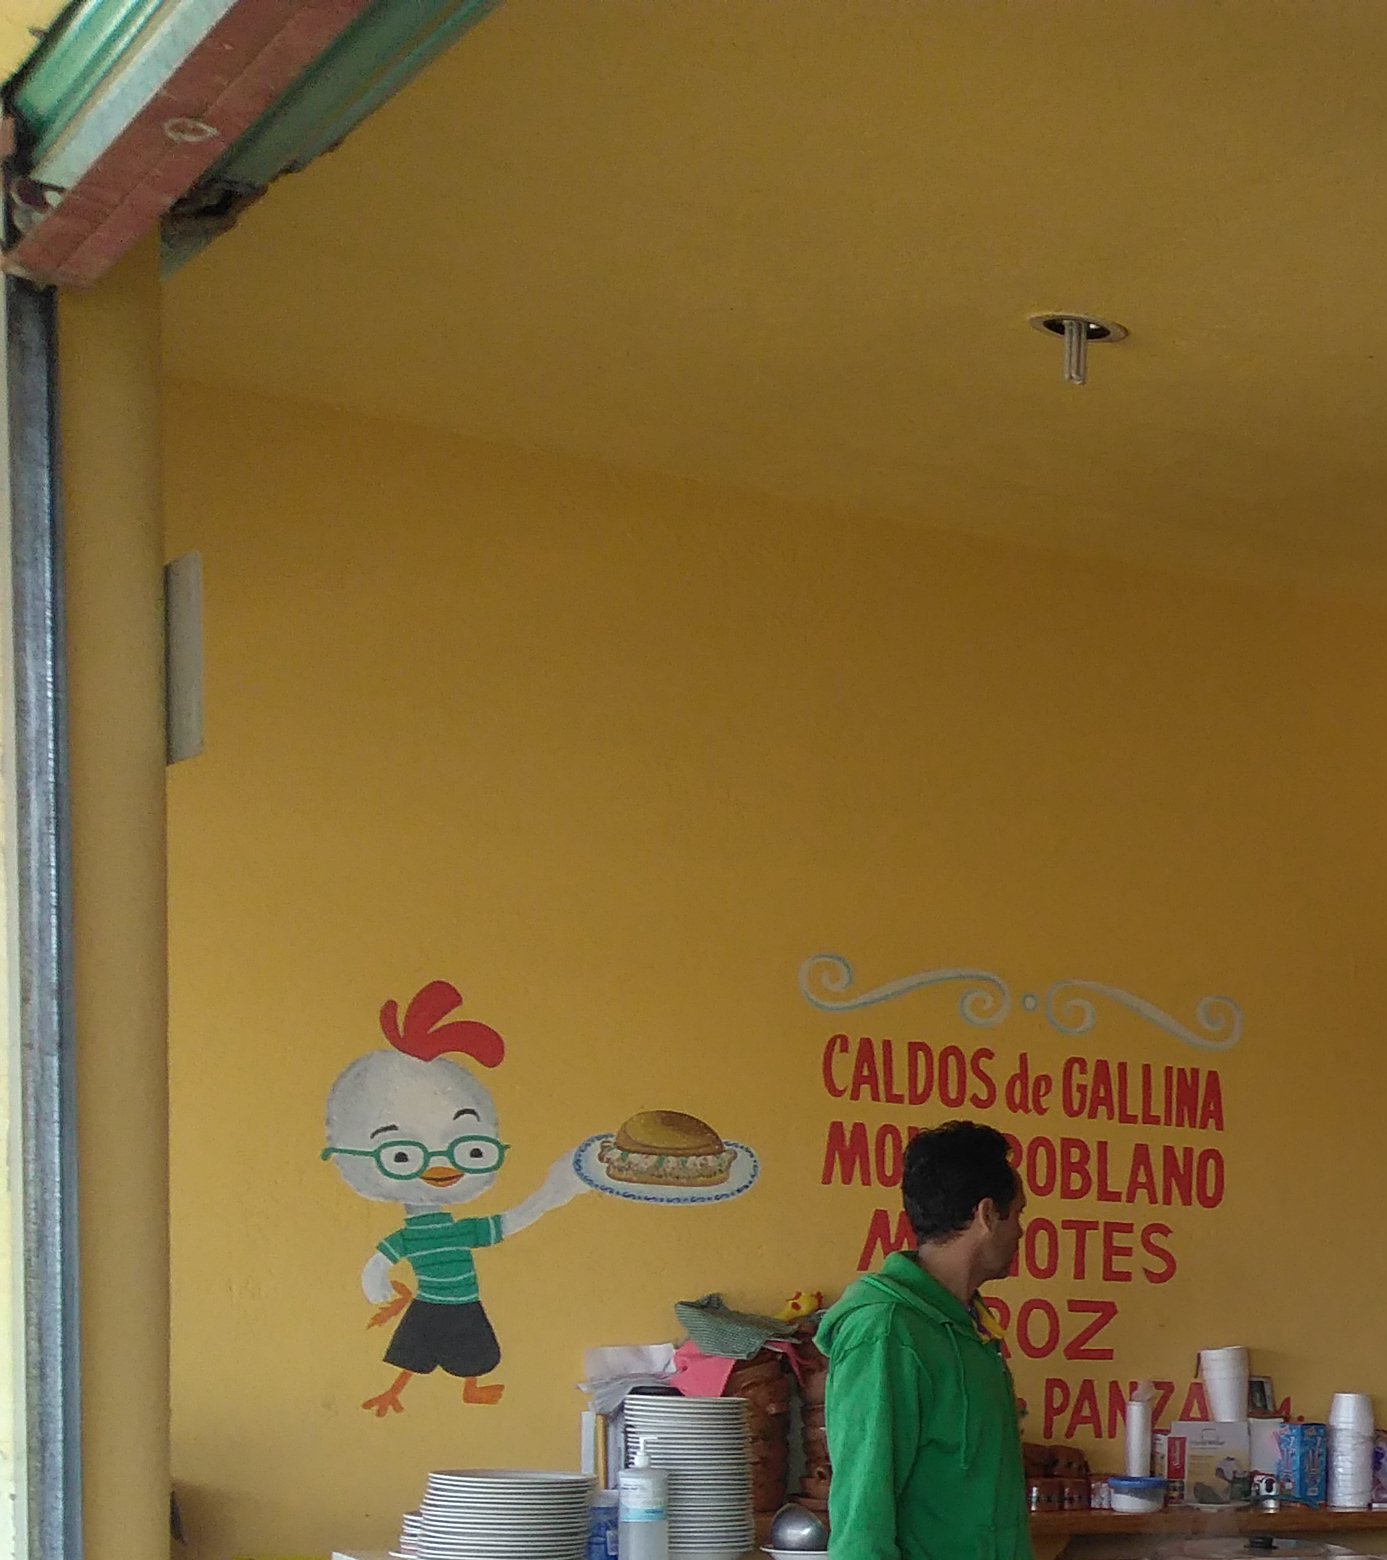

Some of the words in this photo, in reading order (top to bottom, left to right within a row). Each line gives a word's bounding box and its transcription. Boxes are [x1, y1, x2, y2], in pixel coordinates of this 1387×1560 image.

[822, 1034, 997, 1110] CALDOS
[1005, 1052, 1053, 1116] de
[1062, 1056, 1225, 1131] GALLINA
